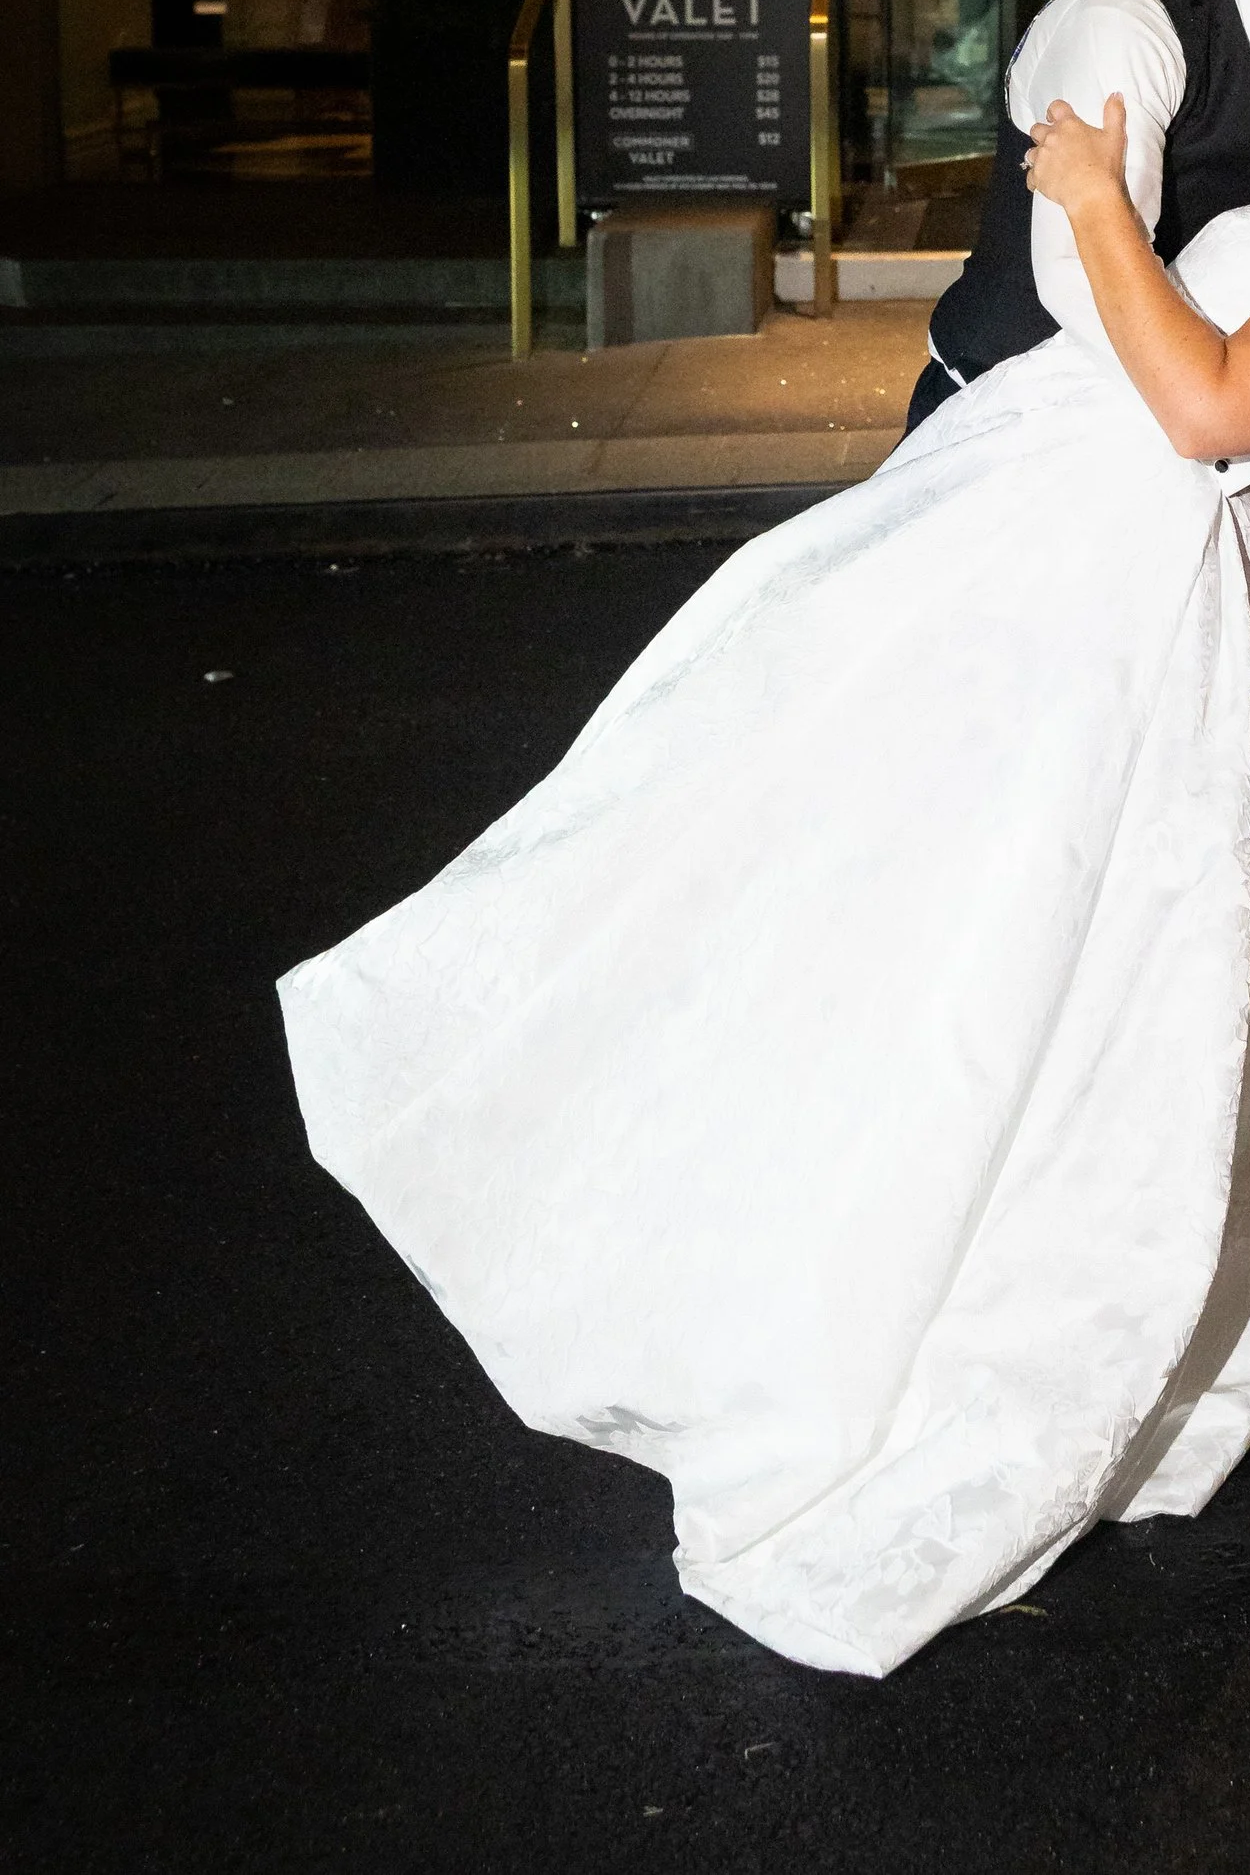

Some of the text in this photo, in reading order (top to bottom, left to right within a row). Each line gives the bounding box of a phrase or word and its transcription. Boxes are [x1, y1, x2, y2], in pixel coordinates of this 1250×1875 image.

[638, 55, 683, 68] HOURS
[638, 72, 684, 85] HOURS
[644, 89, 690, 102] HOURS
[609, 106, 684, 120] OVERNIGHT
[613, 136, 690, 148] COMMONER
[629, 151, 674, 164] VALET
